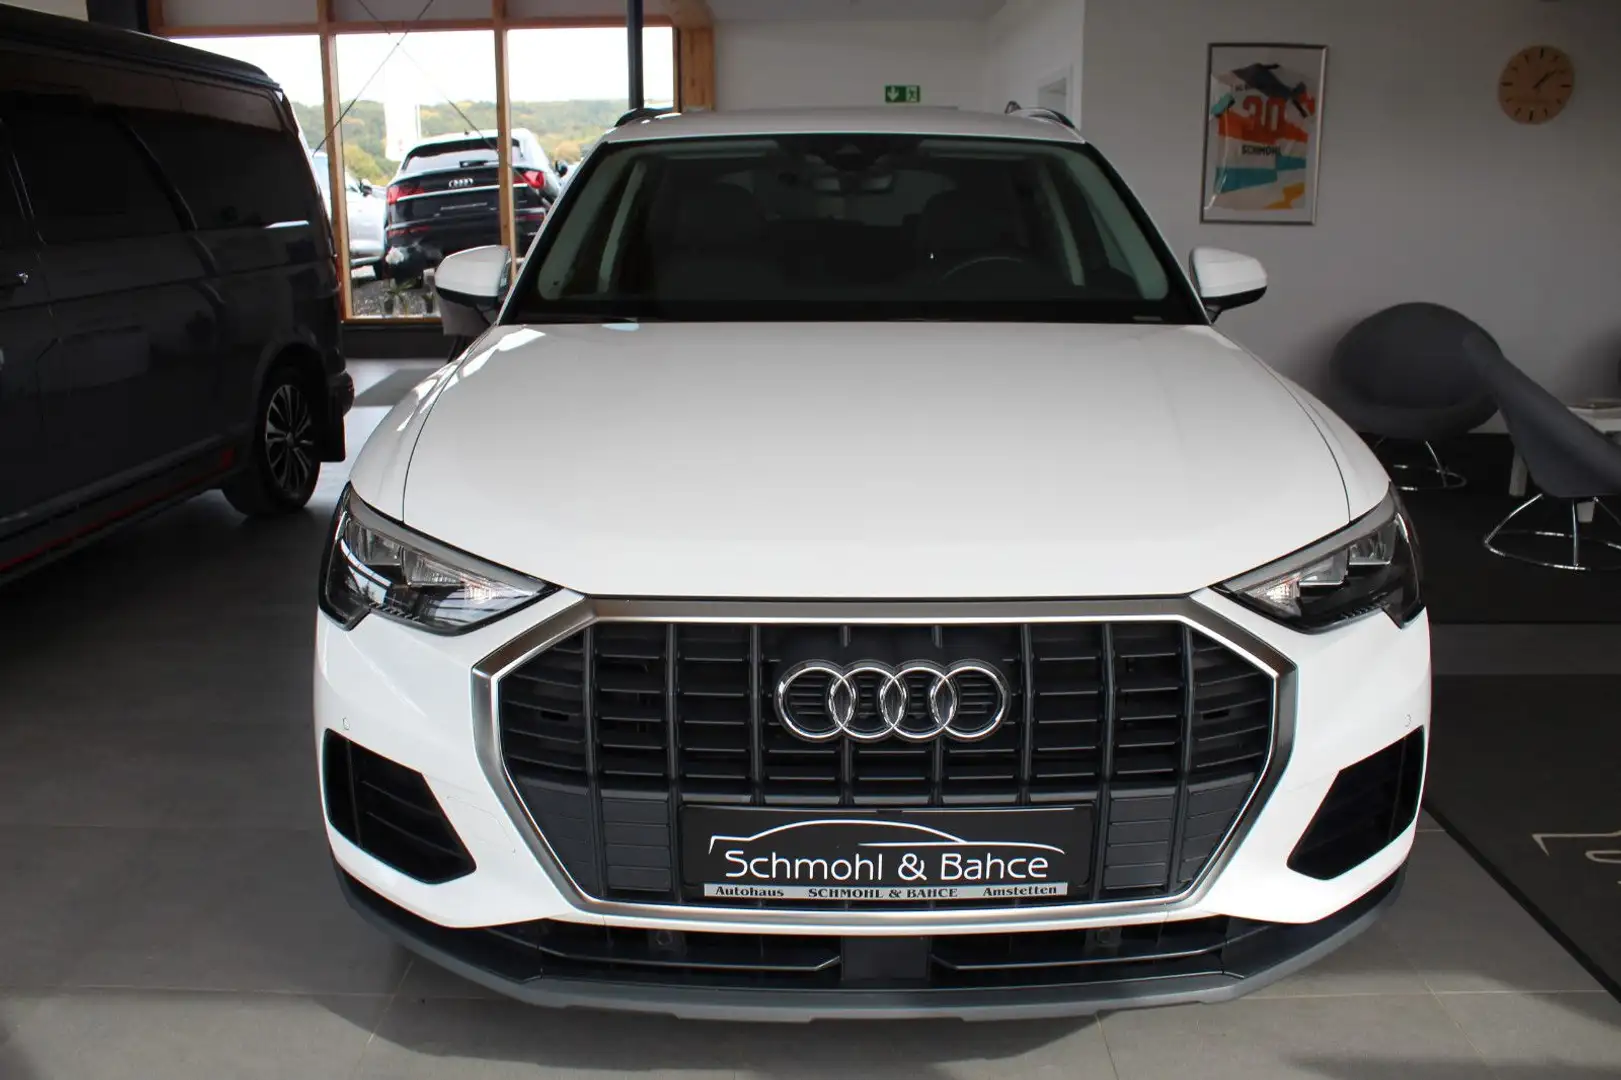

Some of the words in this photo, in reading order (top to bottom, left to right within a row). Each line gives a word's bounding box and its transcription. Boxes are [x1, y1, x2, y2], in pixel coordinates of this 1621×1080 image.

[725, 850, 883, 881] Schmohl
[897, 853, 928, 881] &
[940, 852, 1049, 881] Bahce
[715, 886, 784, 897] Autohaus
[808, 888, 884, 898] SCHMOHL
[888, 888, 902, 898] &
[906, 888, 958, 898] BAHCE
[982, 885, 1057, 896] Amstetten
